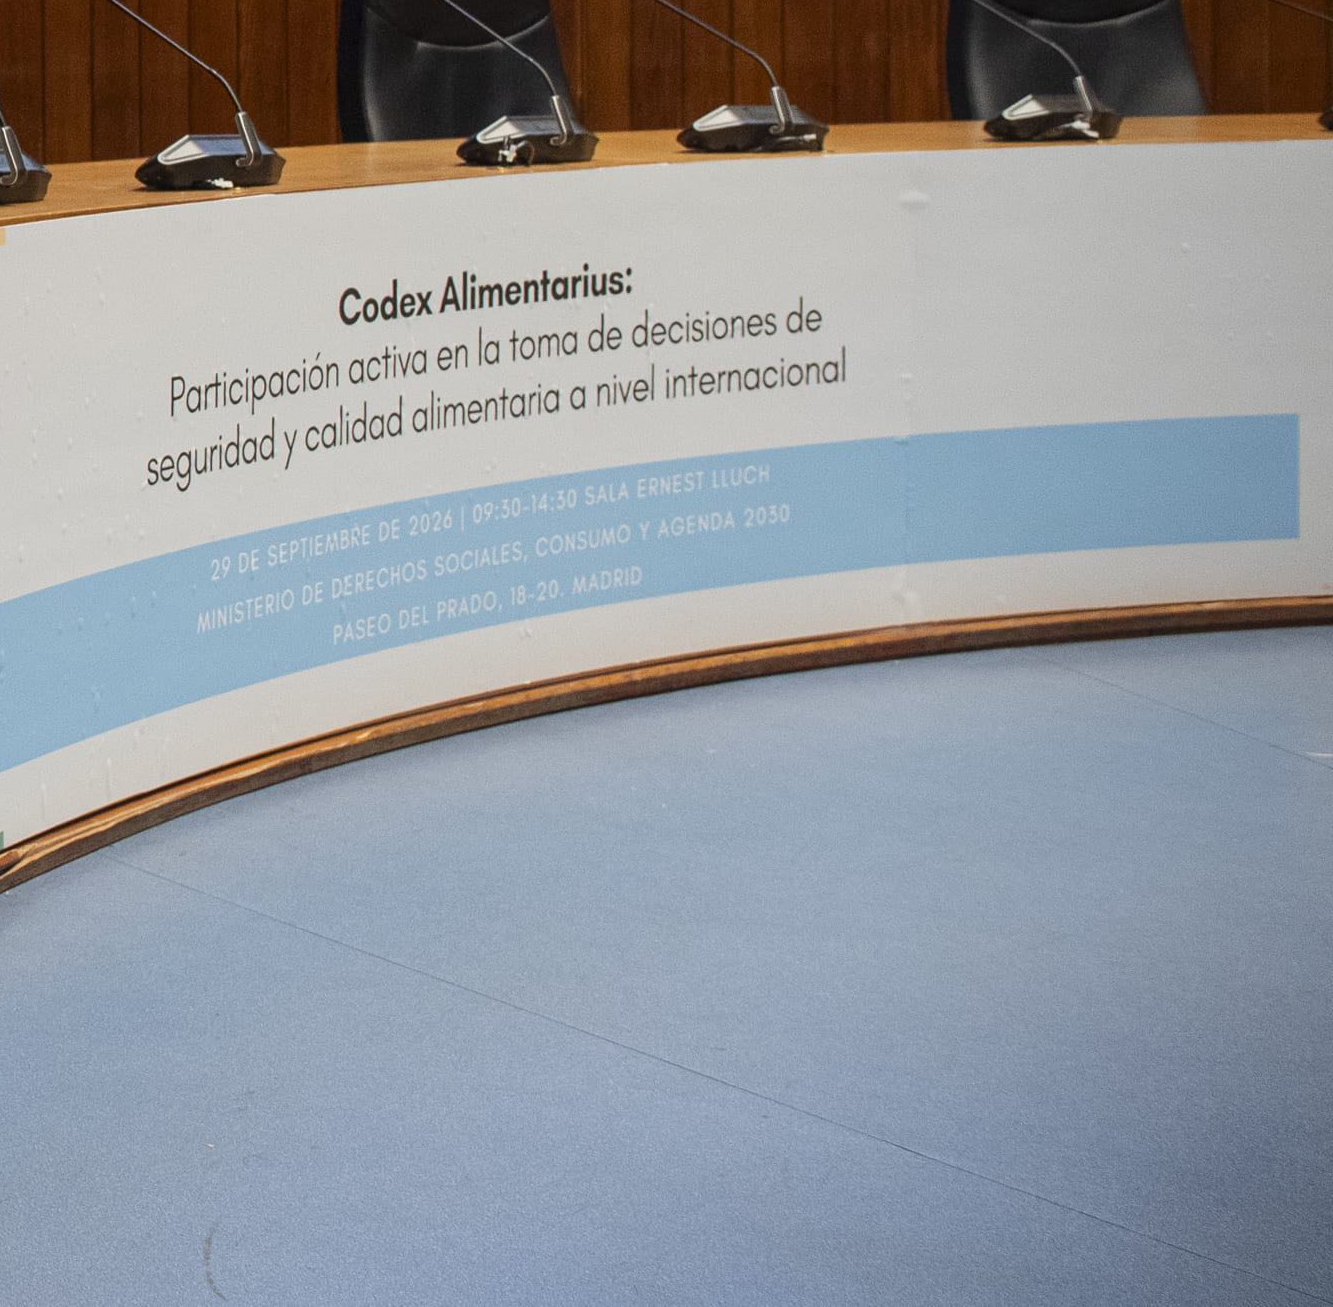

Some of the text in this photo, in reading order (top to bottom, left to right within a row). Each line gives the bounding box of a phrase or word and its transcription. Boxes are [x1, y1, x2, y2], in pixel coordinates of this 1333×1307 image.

[339, 263, 632, 326] Codex Alimentarius:
[171, 297, 822, 417] Participación activa en la toma de decisiones de
[148, 346, 845, 492] seguridad y calidad alimentaria a nivel internacional
[196, 503, 791, 634] MINISTERIO DE DERECHOS SOCIALES, CONSUMO Y AGENDA 2030
[210, 555, 232, 582] 29
[238, 548, 260, 574] DE
[267, 524, 370, 567] SEPTIEMBRE
[378, 518, 400, 542] DE
[409, 509, 453, 537] 2026
[472, 488, 578, 524] 09:30-14:30
[585, 482, 629, 506] SALA
[636, 470, 704, 499] ERNEST
[712, 465, 770, 489] LLUCH
[333, 565, 643, 646] PASEO DEL PRADO, 18-20. MADRID
